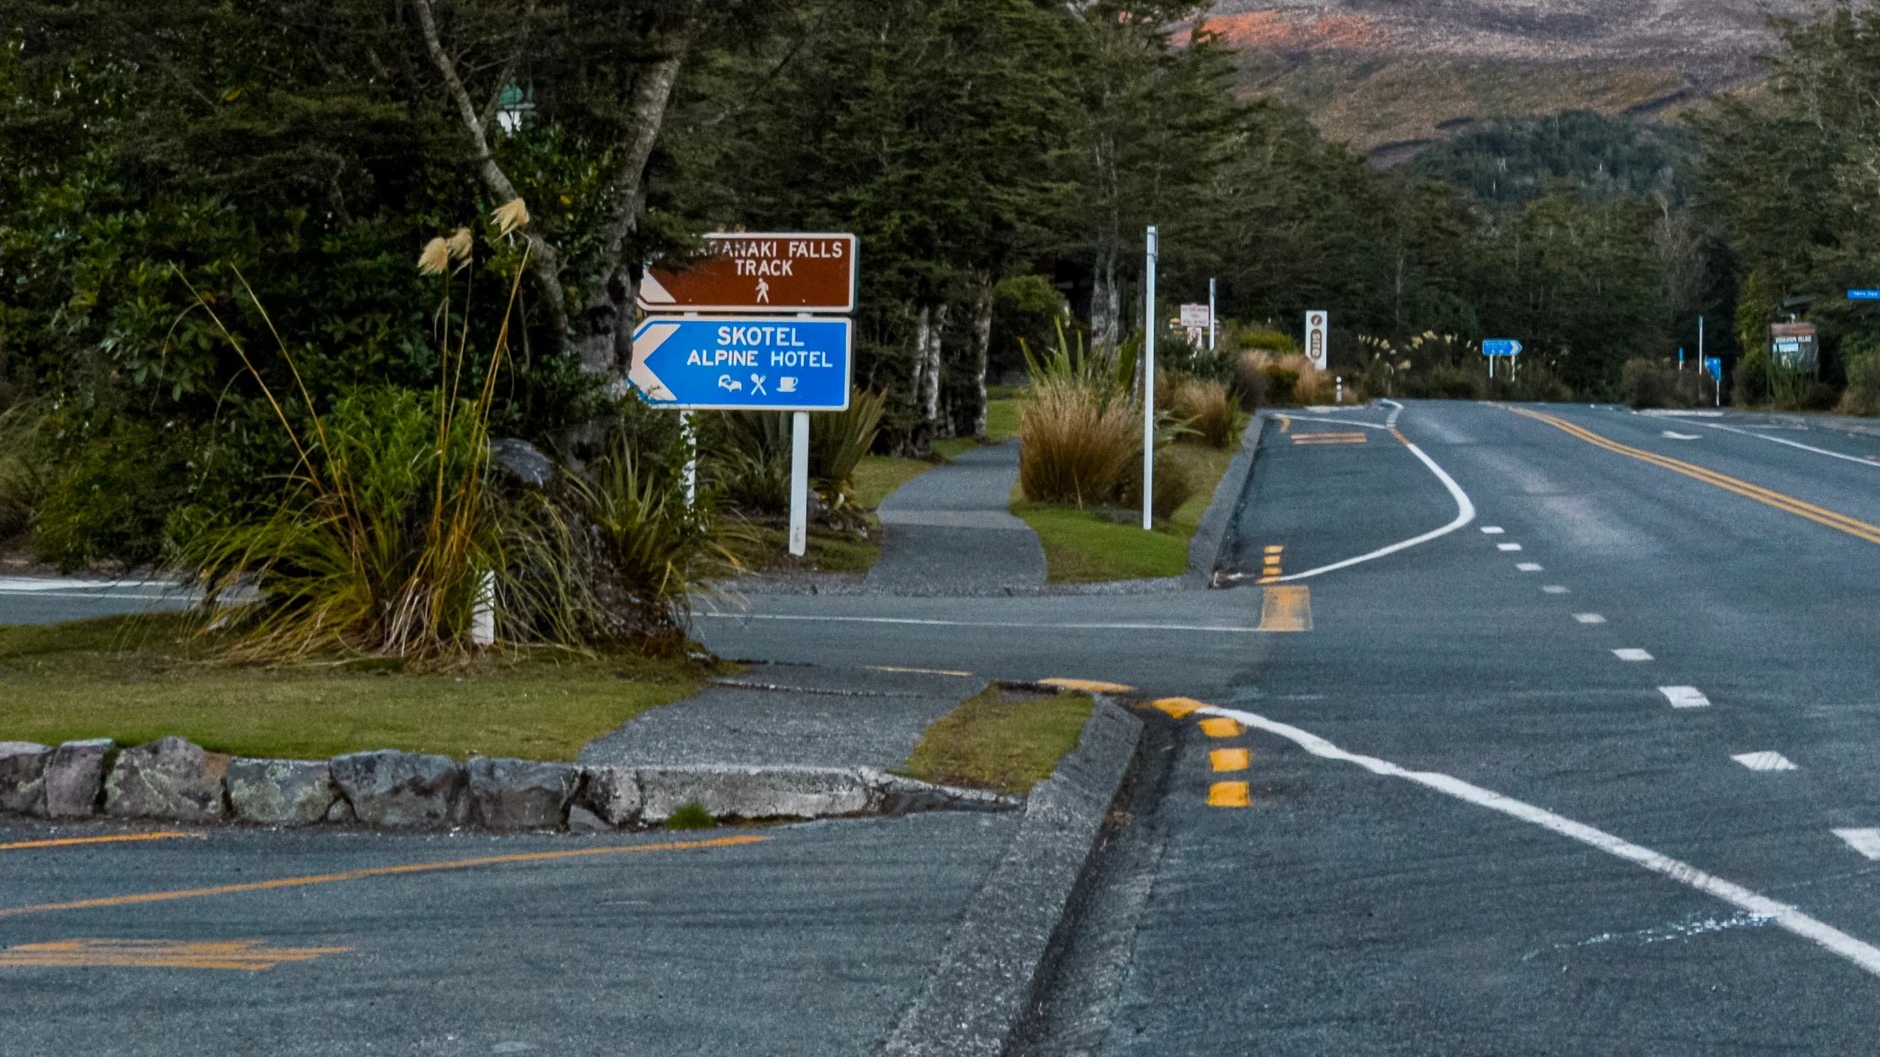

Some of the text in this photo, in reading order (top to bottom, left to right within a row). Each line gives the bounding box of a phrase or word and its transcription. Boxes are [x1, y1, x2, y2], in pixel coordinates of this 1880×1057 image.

[788, 241, 842, 258] FALLS
[735, 259, 793, 276] TRACK
[716, 326, 805, 347] SKOTEL
[686, 349, 833, 368] ALPINE HOTEL
